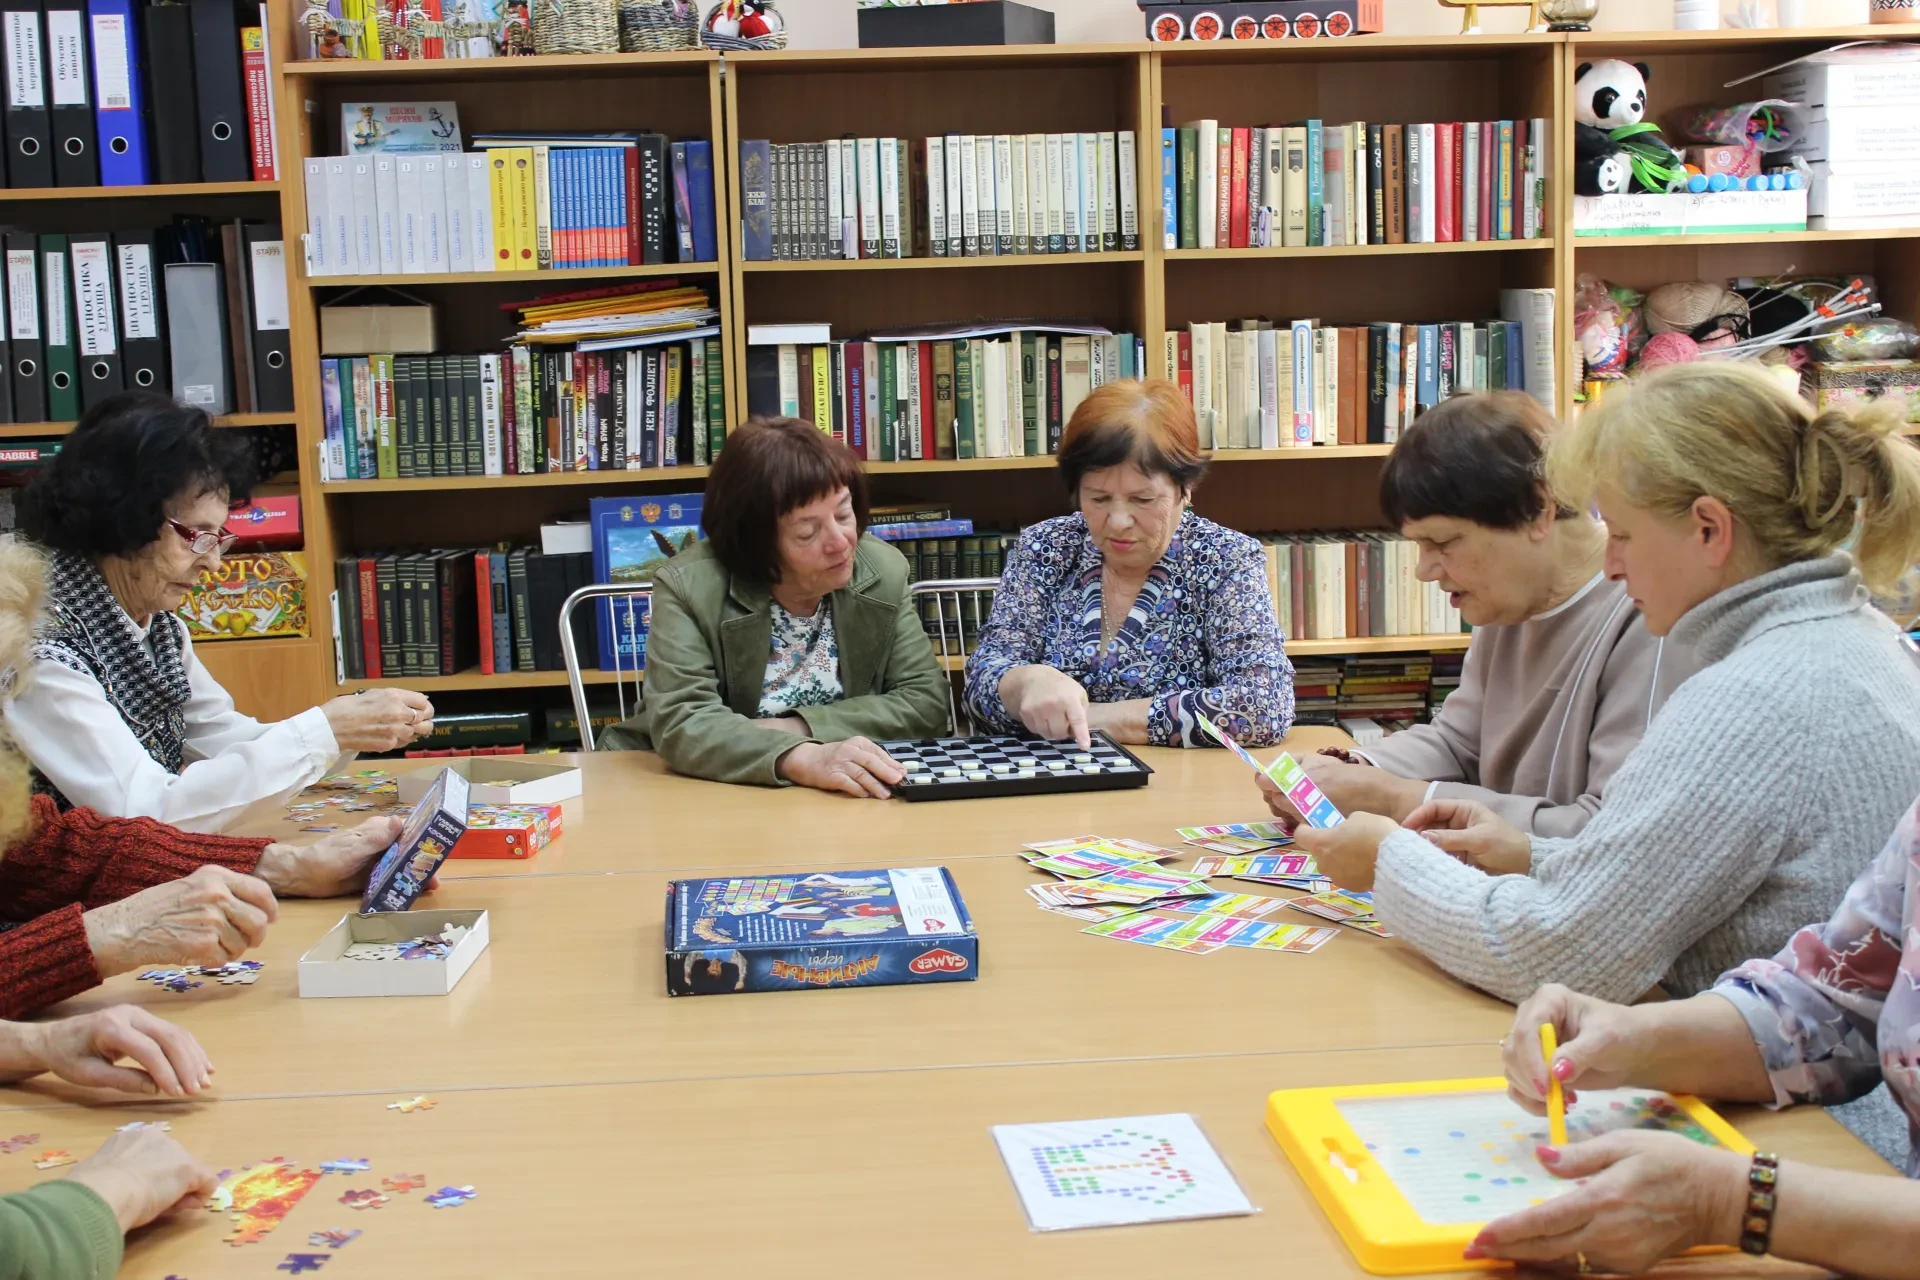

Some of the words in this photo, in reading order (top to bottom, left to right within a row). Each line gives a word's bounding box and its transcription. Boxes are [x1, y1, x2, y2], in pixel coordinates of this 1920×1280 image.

[14, 13, 26, 104] Реабилитационные
[27, 27, 37, 90] мероприятия
[58, 34, 67, 80] Обучение
[70, 36, 78, 79] навыкам
[440, 143, 460, 151] 2021
[1410, 131, 1419, 164] ВИКИНГ
[644, 150, 652, 199] НОВЫЙ
[867, 240, 876, 248] 17
[886, 239, 895, 248] 24
[935, 241, 944, 249] 23
[1001, 235, 1012, 243] 27
[1019, 236, 1025, 244] 6
[1037, 237, 1043, 245] 5
[1051, 235, 1060, 244] 28
[1067, 236, 1076, 244] 16
[1107, 233, 1113, 241] 3
[1125, 235, 1134, 243] 22
[125, 245, 141, 336] ДИАГНОСТИКА
[139, 265, 149, 309] ГРУППА
[81, 261, 98, 354] ДИАГНОСТИКА
[96, 282, 106, 325] ГРУППА
[587, 374, 595, 400] БЛЕЙК
[646, 356, 656, 406] ФОЛЛЕТТ
[851, 367, 859, 386] МИР
[486, 386, 494, 410] ЮМОР
[911, 398, 918, 406] НИ
[646, 410, 655, 431] КЕН
[852, 388, 861, 446] НЕВЕРОЯТНЫЙ
[487, 418, 495, 456] ОДЕССКИЙ
[600, 418, 608, 442] БУНИЧ
[615, 419, 624, 438] БУТ
[601, 442, 609, 462] Игорь
[615, 441, 624, 461] ПАТ
[443, 633, 453, 672] КНИГА
[770, 955, 880, 985] АКТИВНЫЕ
[808, 953, 845, 967] игры
[917, 953, 967, 972] GAMER
